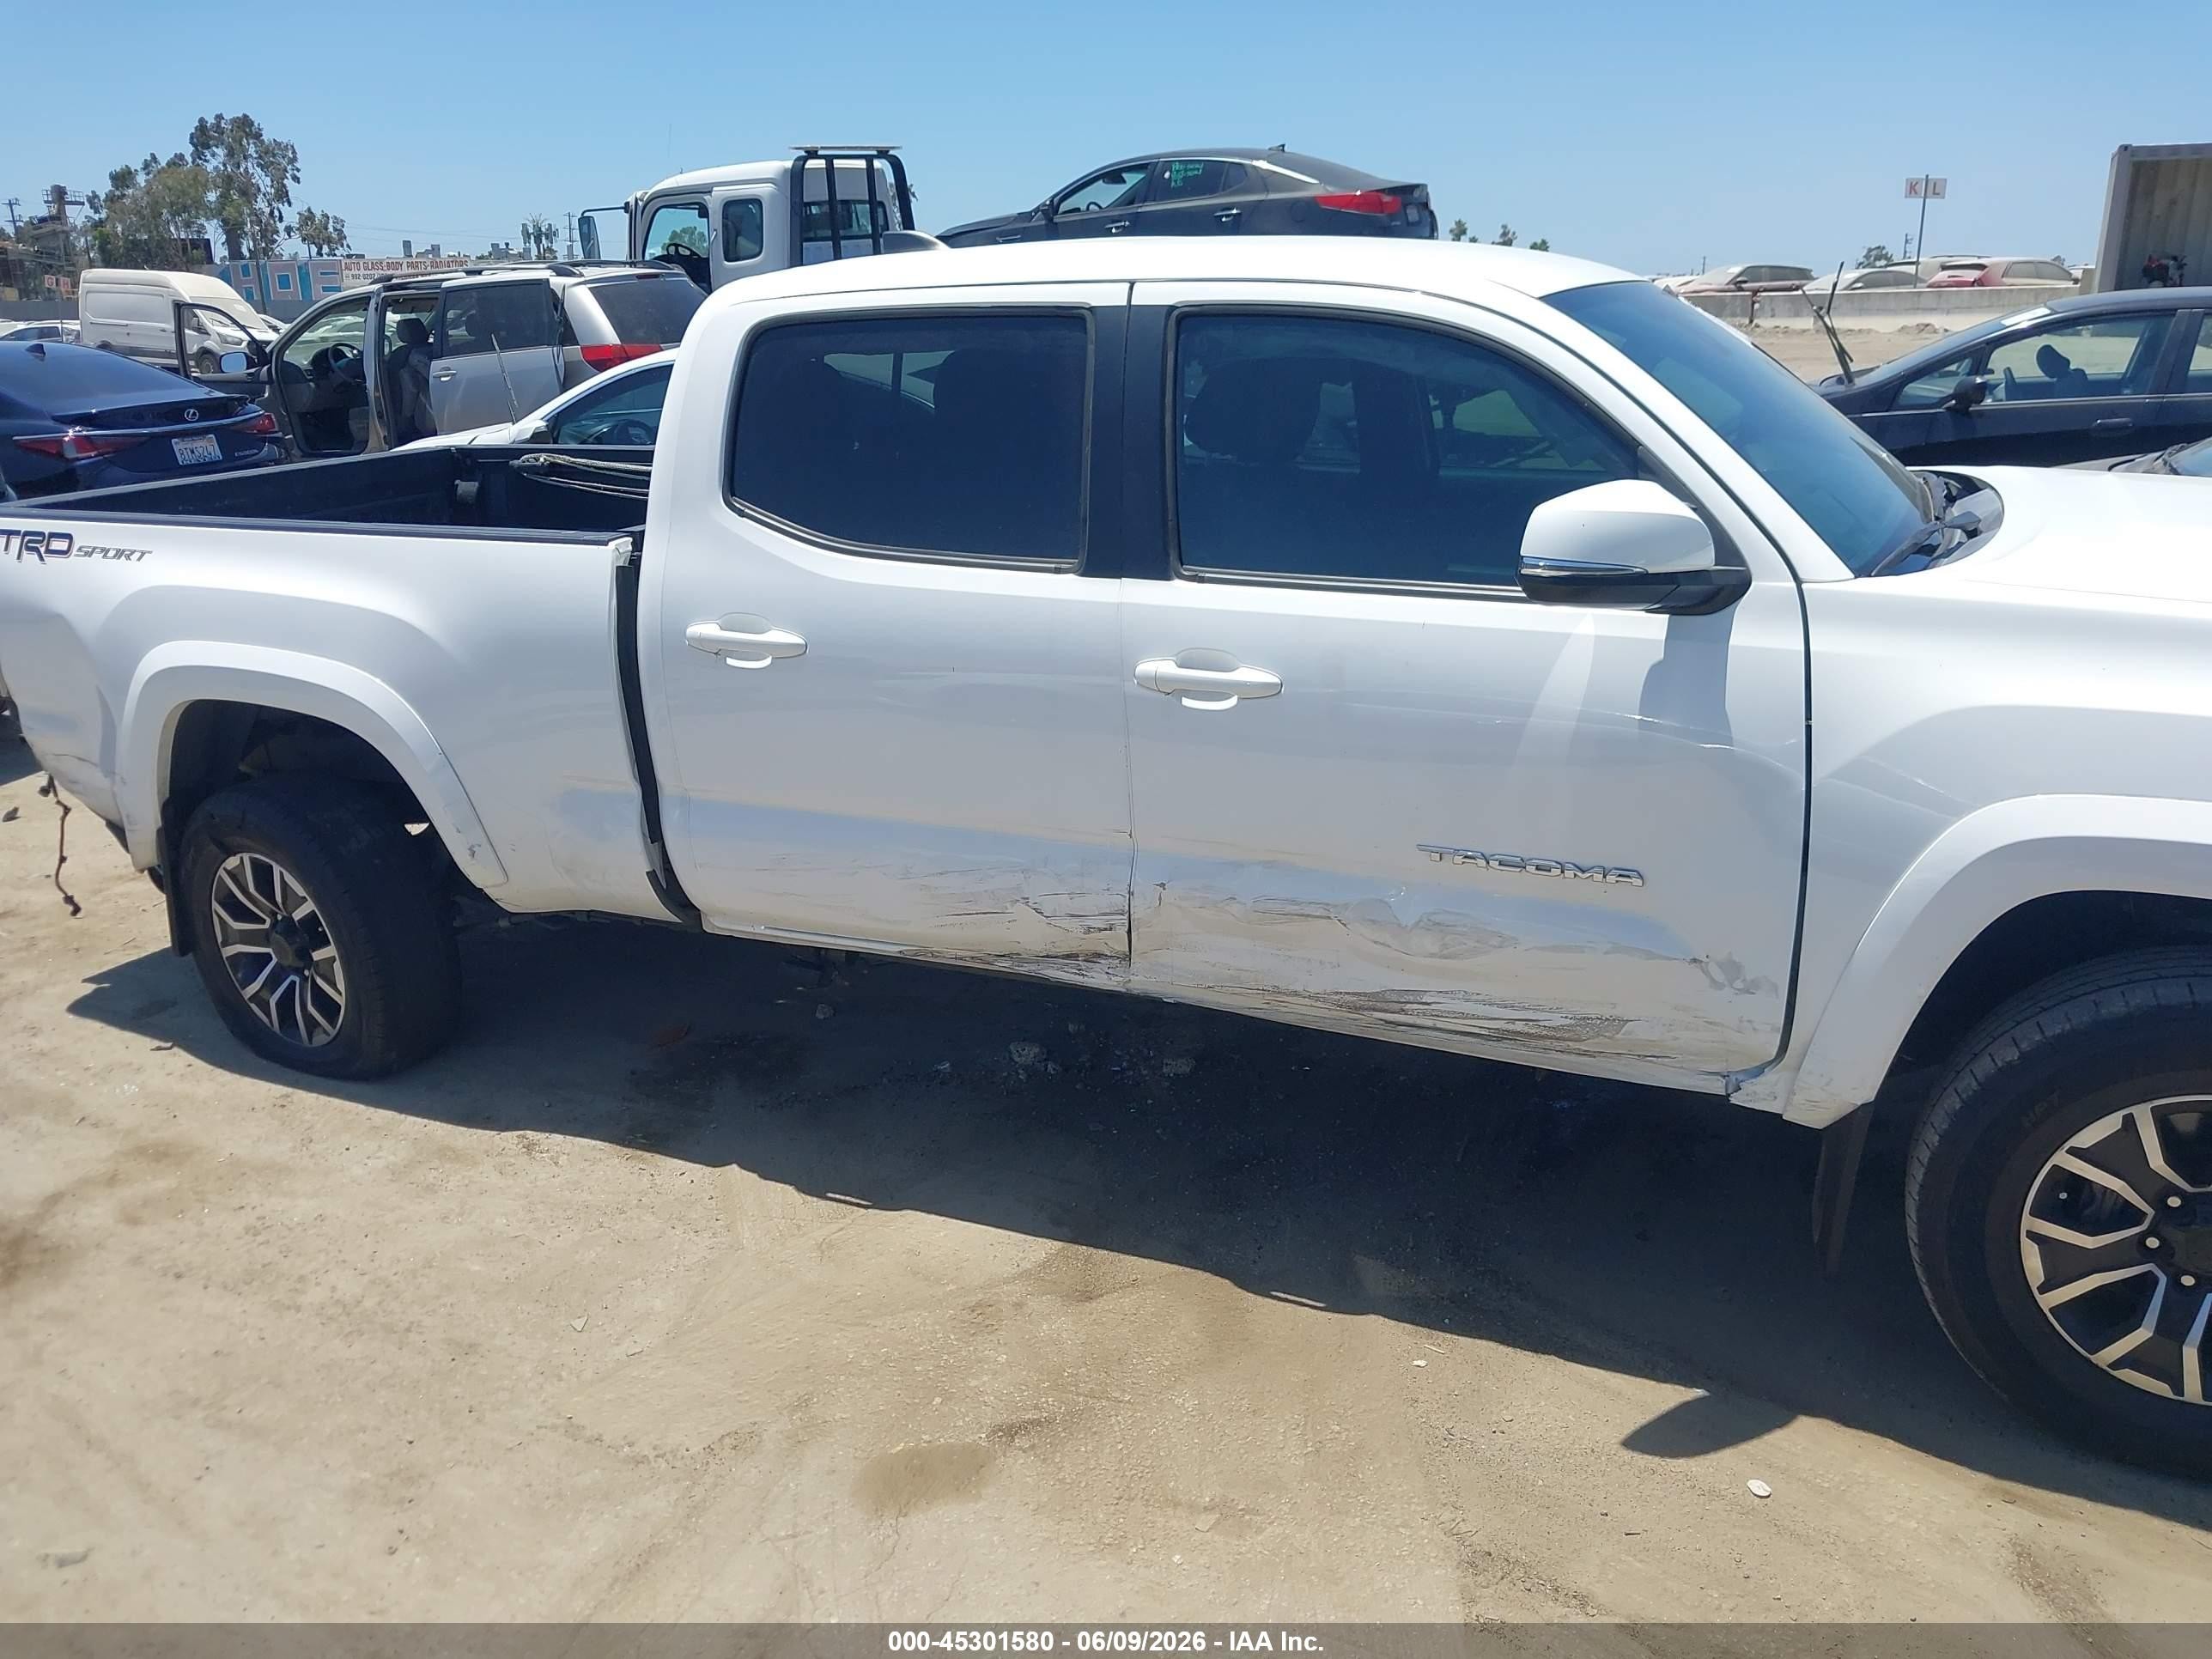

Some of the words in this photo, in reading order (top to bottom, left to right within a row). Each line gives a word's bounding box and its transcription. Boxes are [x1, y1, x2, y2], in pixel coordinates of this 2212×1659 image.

[1909, 181, 1918, 195] K
[1932, 181, 1941, 196] L
[343, 261, 361, 271] AUTO
[47, 276, 55, 287] G
[0, 529, 75, 564] TRD
[74, 544, 154, 562] SPORT
[1416, 844, 1644, 887] TACOMA
